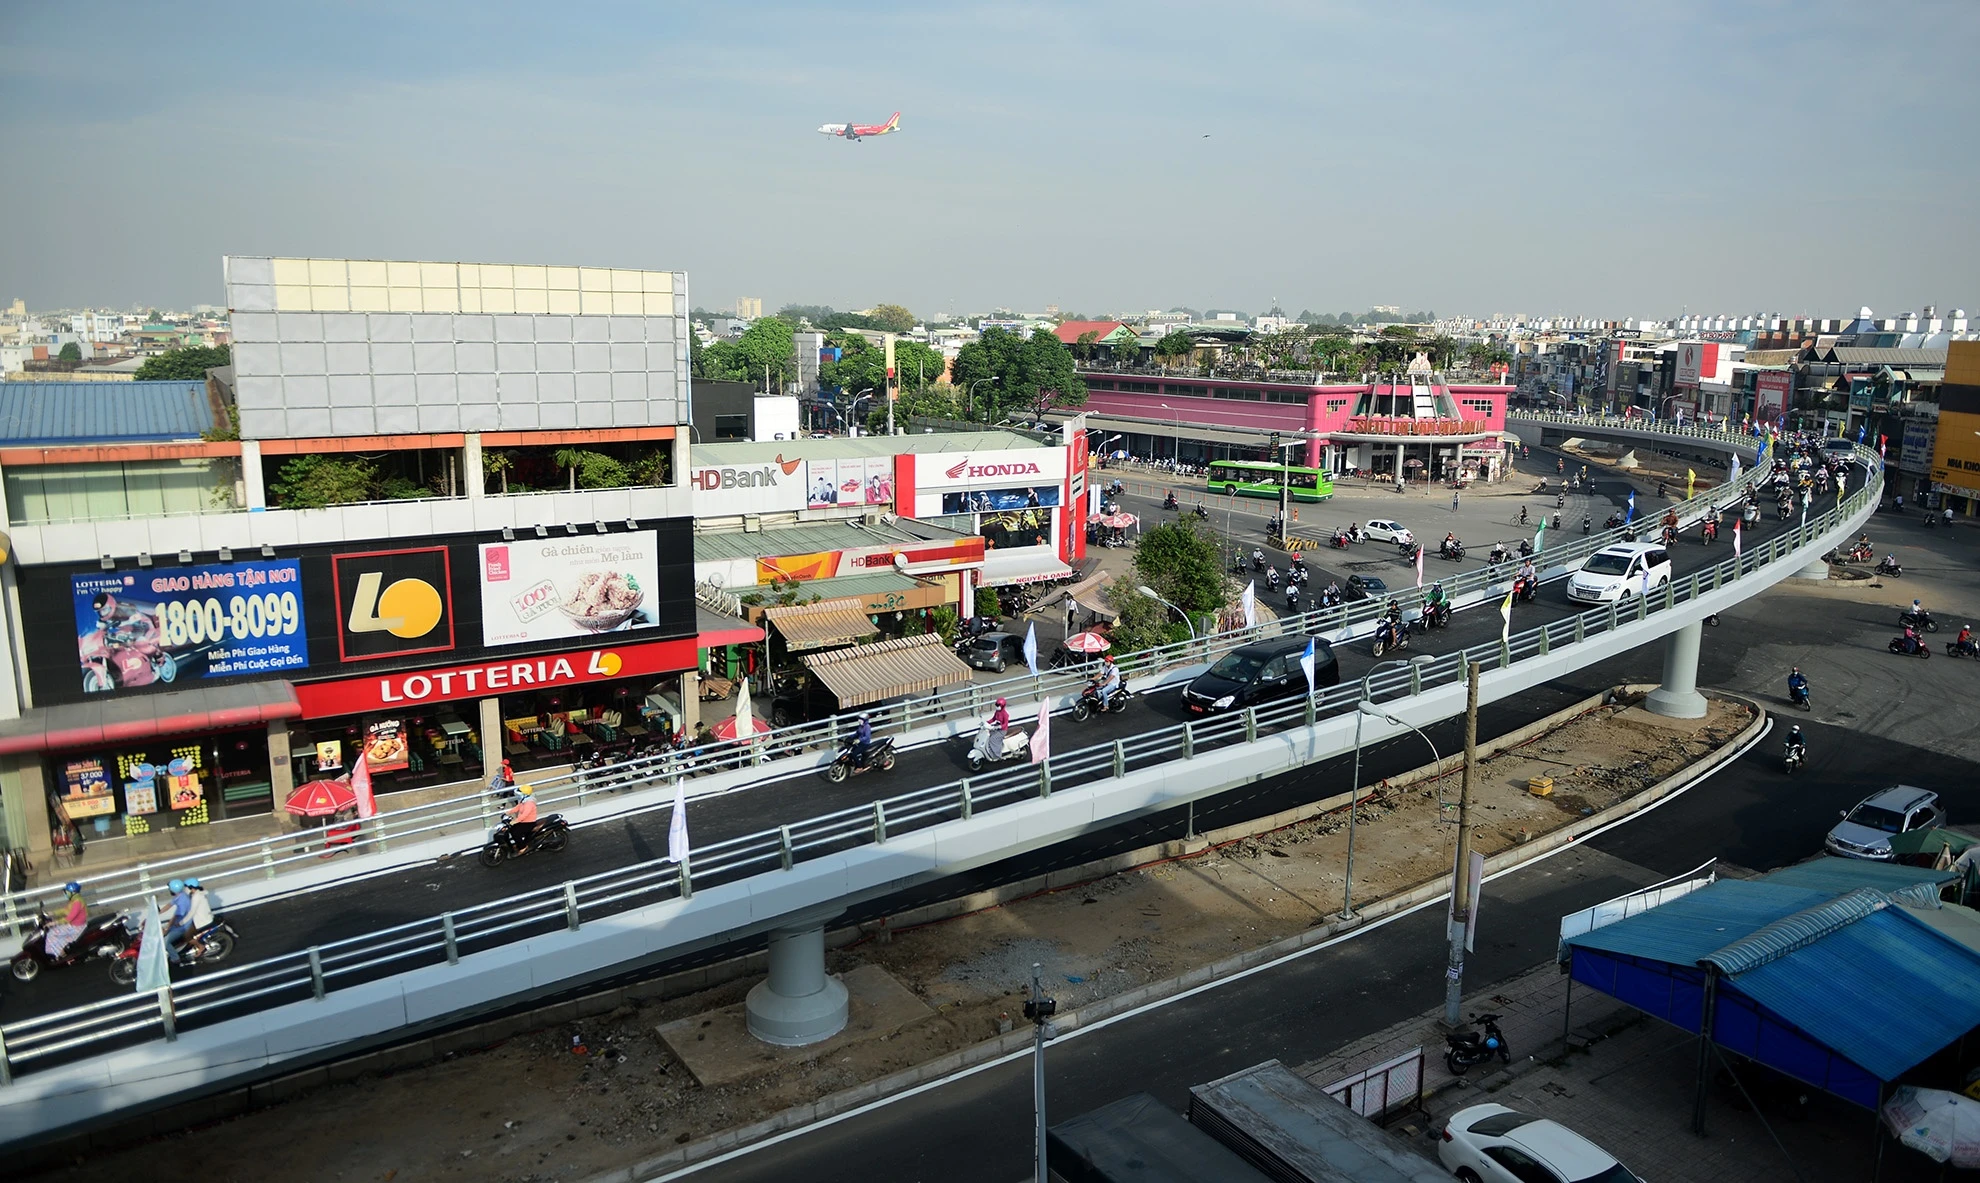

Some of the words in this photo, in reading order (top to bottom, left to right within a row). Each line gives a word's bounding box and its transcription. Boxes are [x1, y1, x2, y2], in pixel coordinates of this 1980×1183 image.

[968, 461, 1041, 478] HONDA
[690, 465, 778, 491] HDBank
[541, 547, 558, 558] Gà
[561, 544, 594, 556] chiên
[601, 552, 619, 564] Mẹ
[621, 550, 644, 561] làm
[851, 555, 890, 568] HDBank
[151, 575, 190, 593] GIAO
[192, 570, 235, 590] HÀNG
[236, 567, 267, 588] TẬN
[268, 568, 297, 584] NƠI
[1050, 571, 1072, 580] OANH
[75, 579, 122, 589] LOTTERIA
[101, 586, 122, 595] happy
[515, 583, 553, 612] 100%
[155, 591, 299, 647] 1800-8099
[491, 633, 520, 641] LOTTERIA
[208, 648, 231, 660] Miễn
[232, 647, 246, 658] Phí
[247, 646, 267, 656] Giao
[268, 644, 290, 654] Hàng
[209, 661, 232, 673] Miễn
[233, 660, 247, 671] Phí
[248, 658, 270, 670] Cuộc
[270, 657, 285, 668] Gọi
[286, 654, 303, 665] Đến
[380, 657, 576, 702] LOTTERIA
[519, 726, 545, 735] LOTTERIA
[221, 769, 252, 779] LOTTERIA
